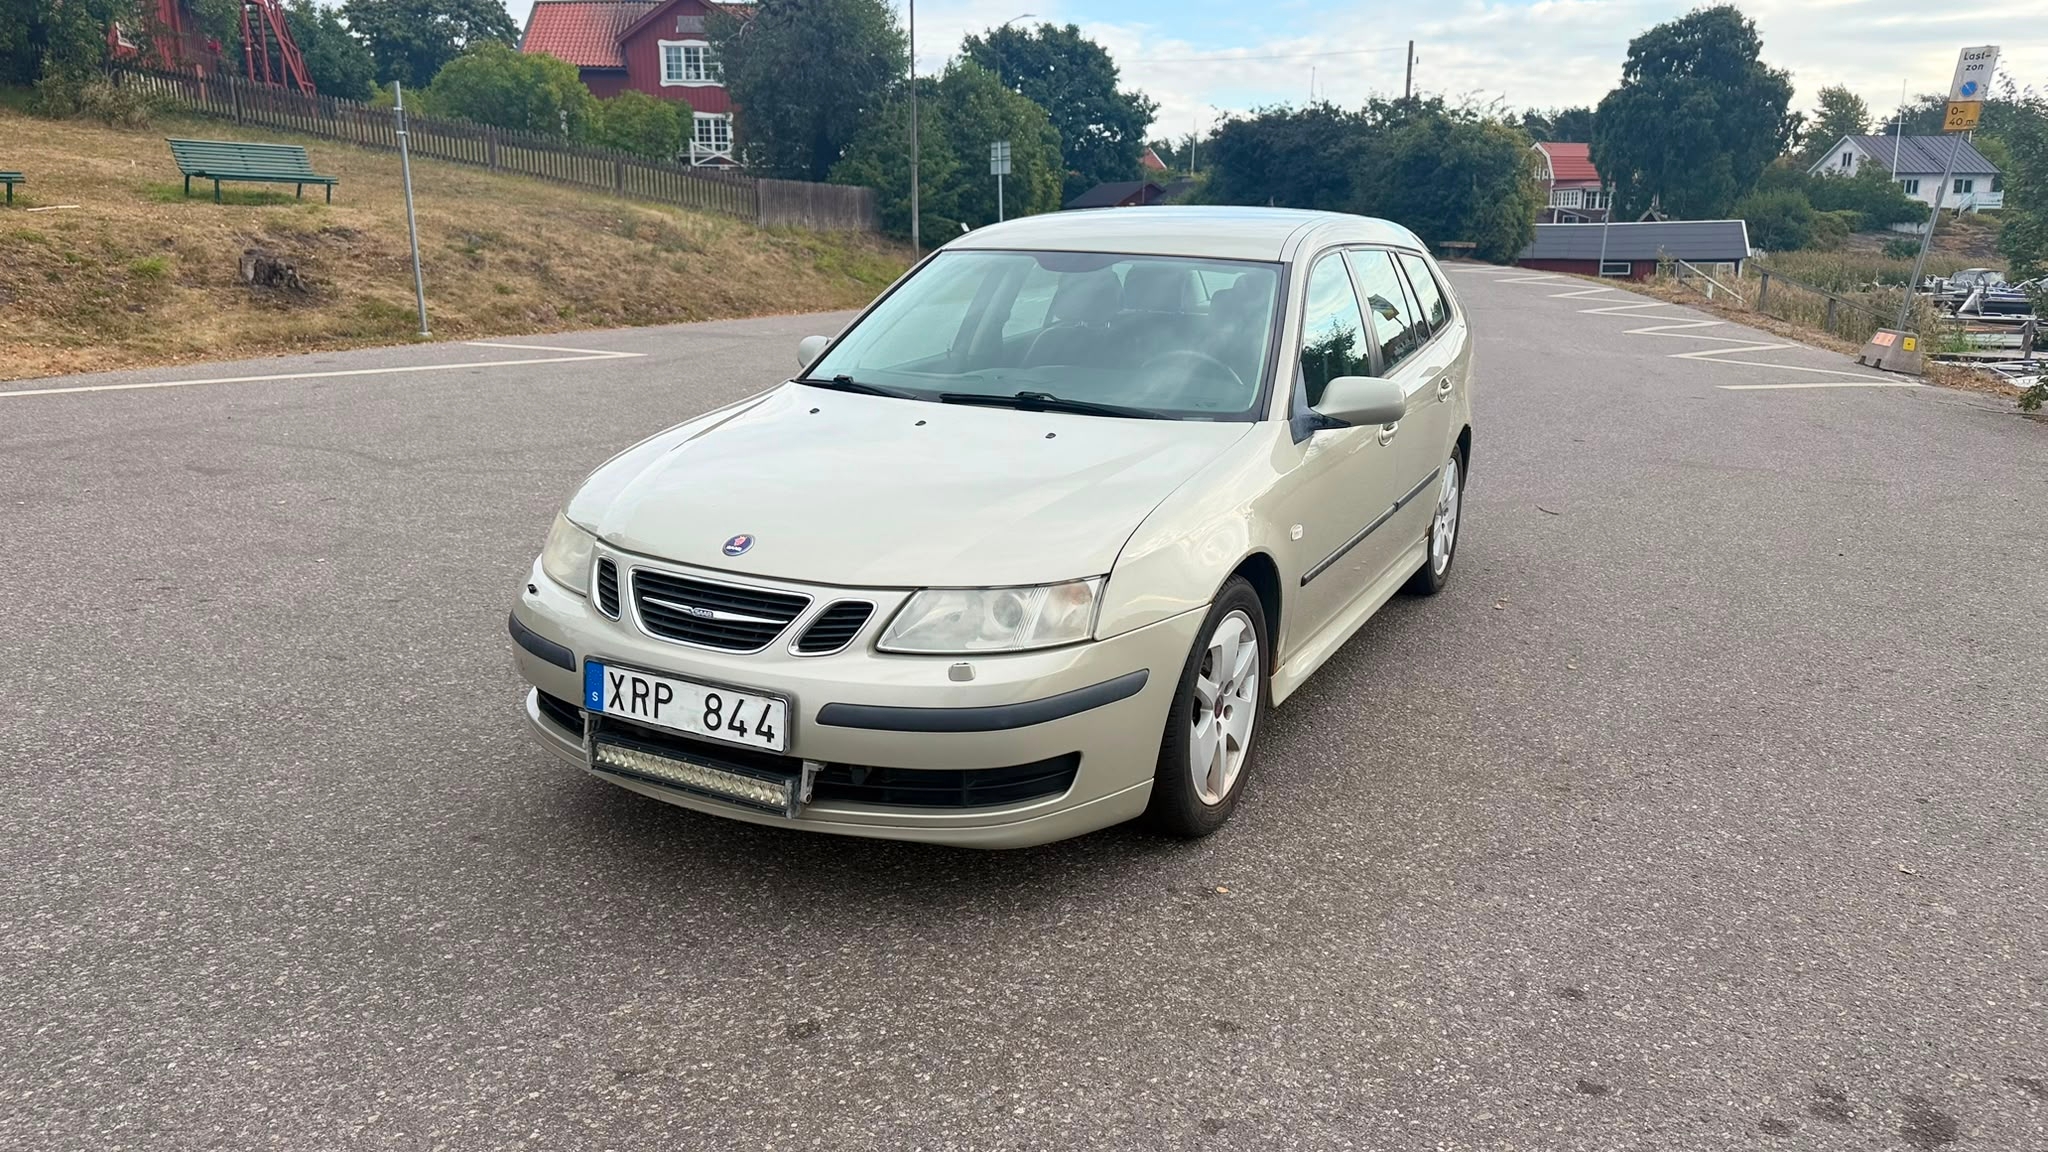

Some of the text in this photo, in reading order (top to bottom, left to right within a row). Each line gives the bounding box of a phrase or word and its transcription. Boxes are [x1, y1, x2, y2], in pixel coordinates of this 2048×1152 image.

[1963, 51, 1992, 61] Last-
[1965, 63, 1984, 71] zon
[1951, 106, 1965, 115] 0-
[1949, 117, 1963, 126] 40
[591, 691, 599, 702] S
[608, 671, 775, 743] XRP 844
